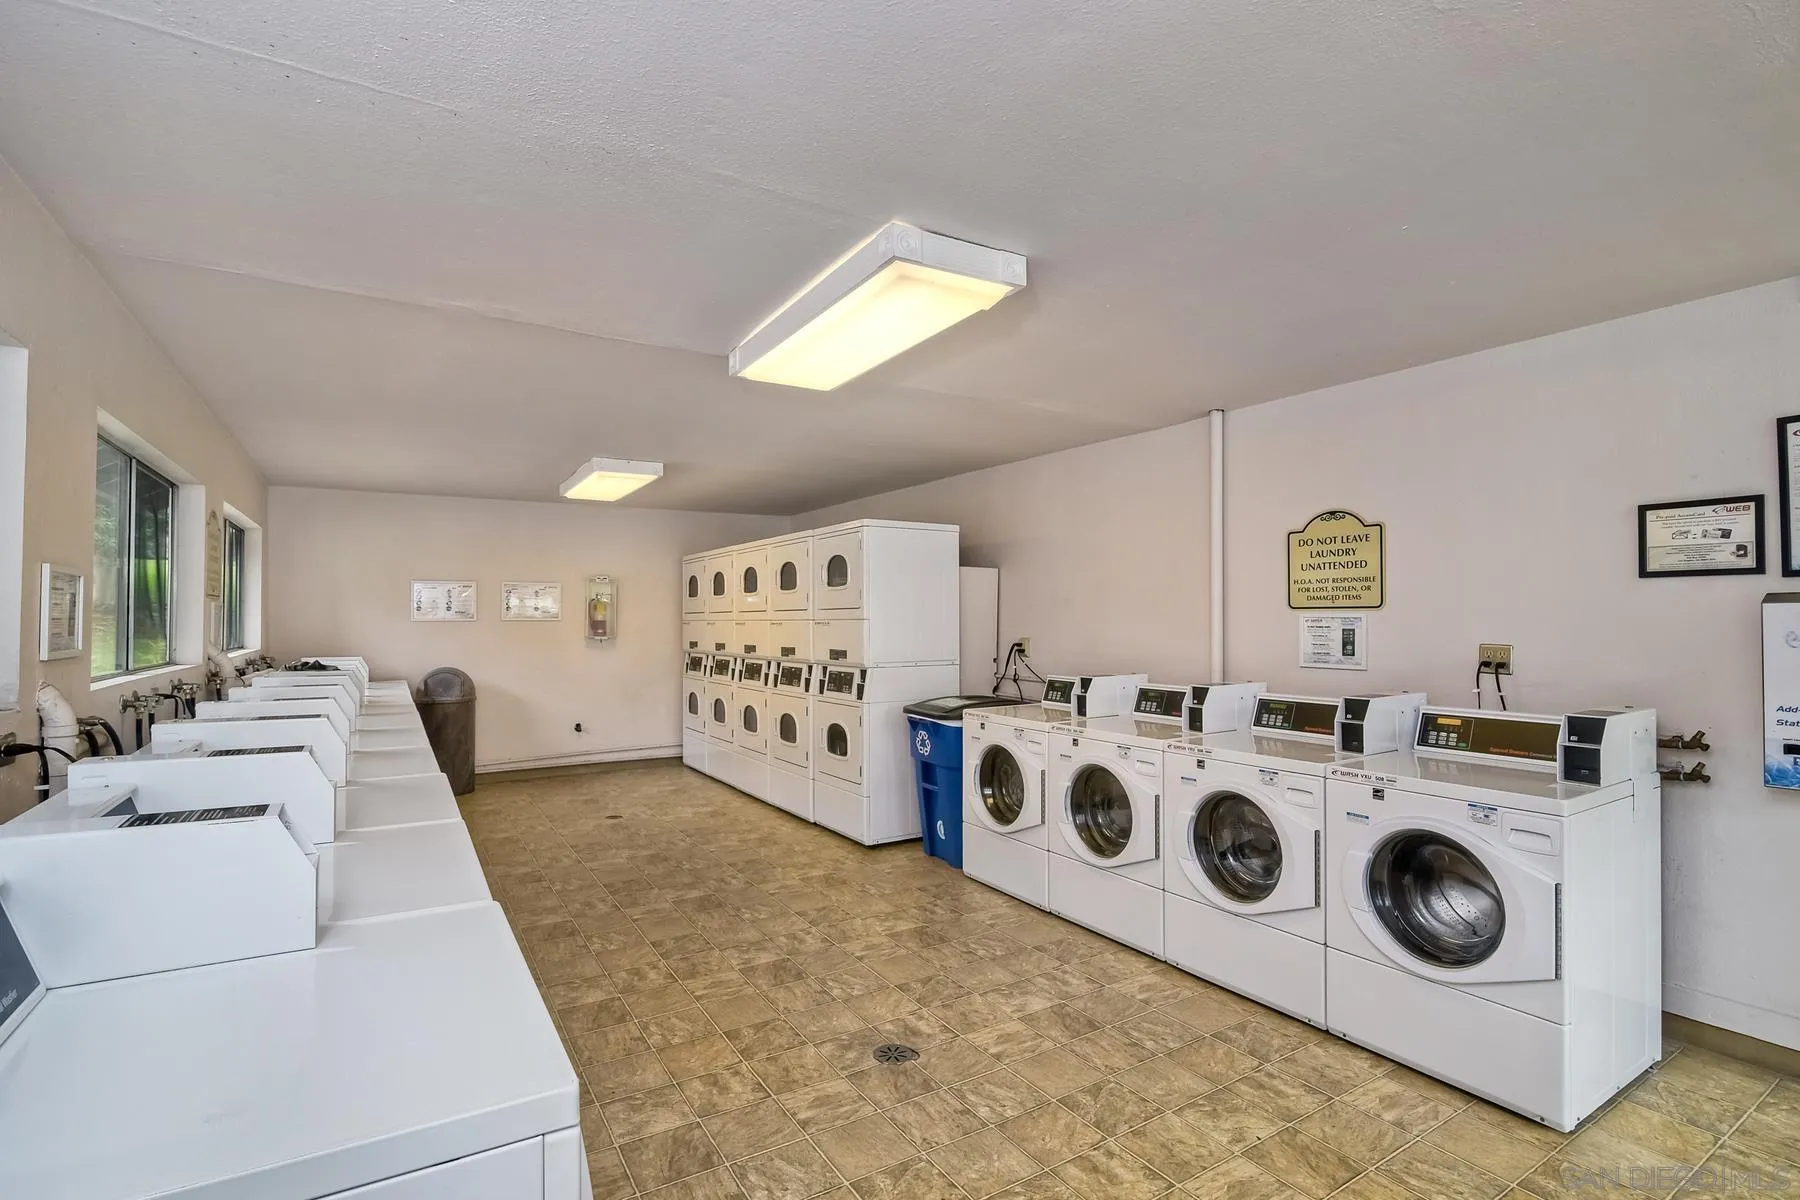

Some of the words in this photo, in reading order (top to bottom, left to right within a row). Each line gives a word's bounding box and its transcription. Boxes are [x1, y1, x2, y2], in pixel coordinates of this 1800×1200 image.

[1725, 504, 1751, 513] WEB
[1298, 538, 1314, 548] DO
[1316, 536, 1338, 546] NOT
[1341, 533, 1371, 544] LEAVE
[1310, 547, 1357, 558] LAUNDRY
[1301, 559, 1368, 571] UNATTENDED
[1331, 575, 1377, 584] RESPONSIBLE
[1331, 585, 1359, 593] STOLEN,
